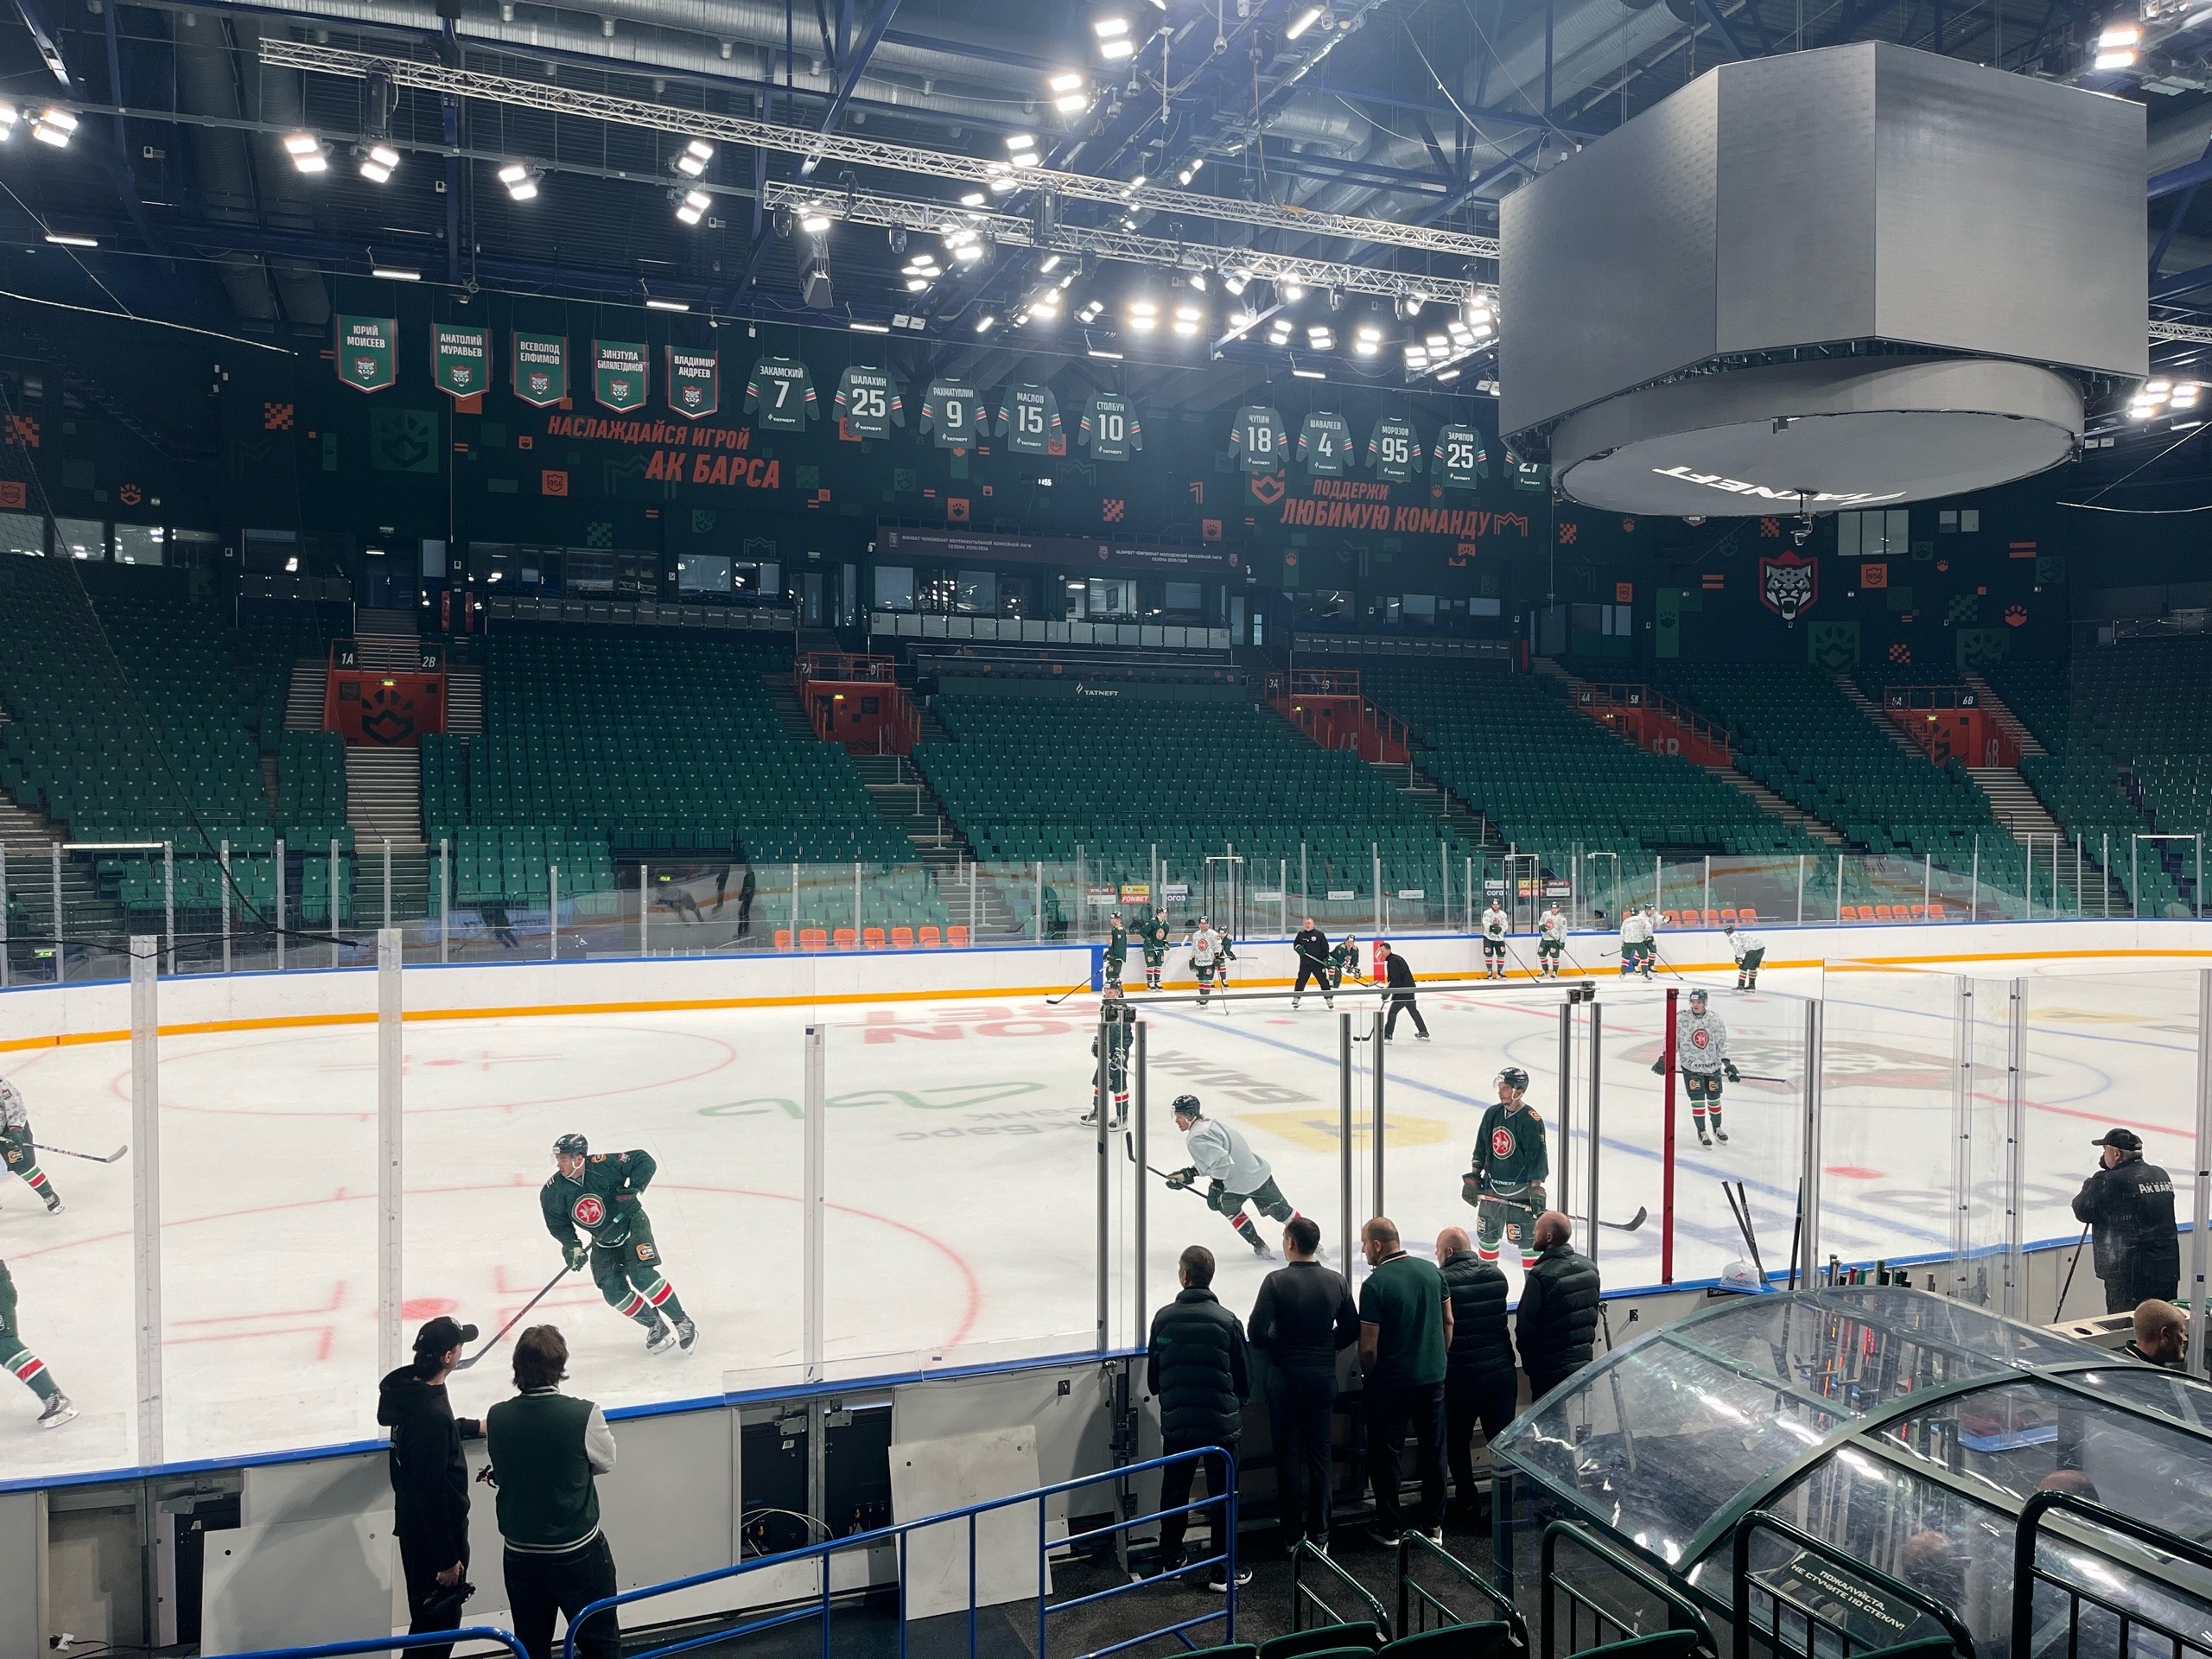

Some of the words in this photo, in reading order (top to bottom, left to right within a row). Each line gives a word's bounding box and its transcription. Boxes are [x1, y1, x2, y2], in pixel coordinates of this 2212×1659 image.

[353, 325, 378, 336] ЮРИЙ
[346, 336, 385, 348] МОИСЕЕВ
[441, 334, 482, 346] АНАТОЛИЙ
[441, 345, 482, 357] МУРАВЬЕВ
[520, 341, 560, 355] ВСЕВОЛОД
[520, 353, 560, 365] ЕЛФИМОВ
[601, 349, 639, 361] ЗИНЭТУЛА
[597, 360, 644, 372] БИЛЯЛЕТДИНОВ
[674, 355, 715, 368] ВЛАДИМИР
[678, 366, 710, 378] АНДРЕЕВ
[760, 365, 804, 378] ЗАКАМСКИЙ
[851, 374, 887, 386] ШАЛАХИН
[773, 380, 790, 408] 7
[933, 387, 974, 398] РАХМАТУЛЛИН
[1017, 392, 1045, 404] МАСЛОВ
[852, 388, 886, 417] 25
[1096, 401, 1125, 412] СТОЛБУН
[946, 401, 963, 428] 9
[1018, 405, 1043, 433] 15
[1249, 415, 1269, 424] ЧУПИН
[1098, 414, 1124, 442] 10
[1310, 419, 1342, 430] ШАВАЛЕЕВ
[1382, 425, 1409, 436] МОРОЗОВ
[547, 415, 688, 445] НАСЛАЖДАЙСЯ
[691, 426, 750, 450] ИГРОЙ
[1447, 431, 1474, 442] ЗАРИПОВ
[1247, 427, 1272, 453] 18
[1318, 432, 1332, 457] 4
[1382, 437, 1408, 463] 95
[1447, 443, 1474, 468] 25
[645, 449, 687, 481] АК
[693, 454, 779, 489] БАРСА
[1313, 479, 1389, 501] ПОДДЕРЖИ
[1280, 498, 1390, 531] ЛЮБИМУЮ
[1394, 506, 1491, 540] КОМАНДУ
[341, 652, 353, 664] 1A
[422, 656, 436, 668] 2B
[1630, 695, 1639, 704] 5B
[1962, 696, 1974, 705] 6B
[1491, 1178, 1516, 1186] TATNEFT
[1819, 1570, 1885, 1611] ПОЖАЛУЙСТА,
[1791, 1564, 1806, 1575] НЕ
[1805, 1572, 1850, 1599] СТУЧИТЕ
[1863, 1605, 1906, 1630] СТЕКЛУ!
